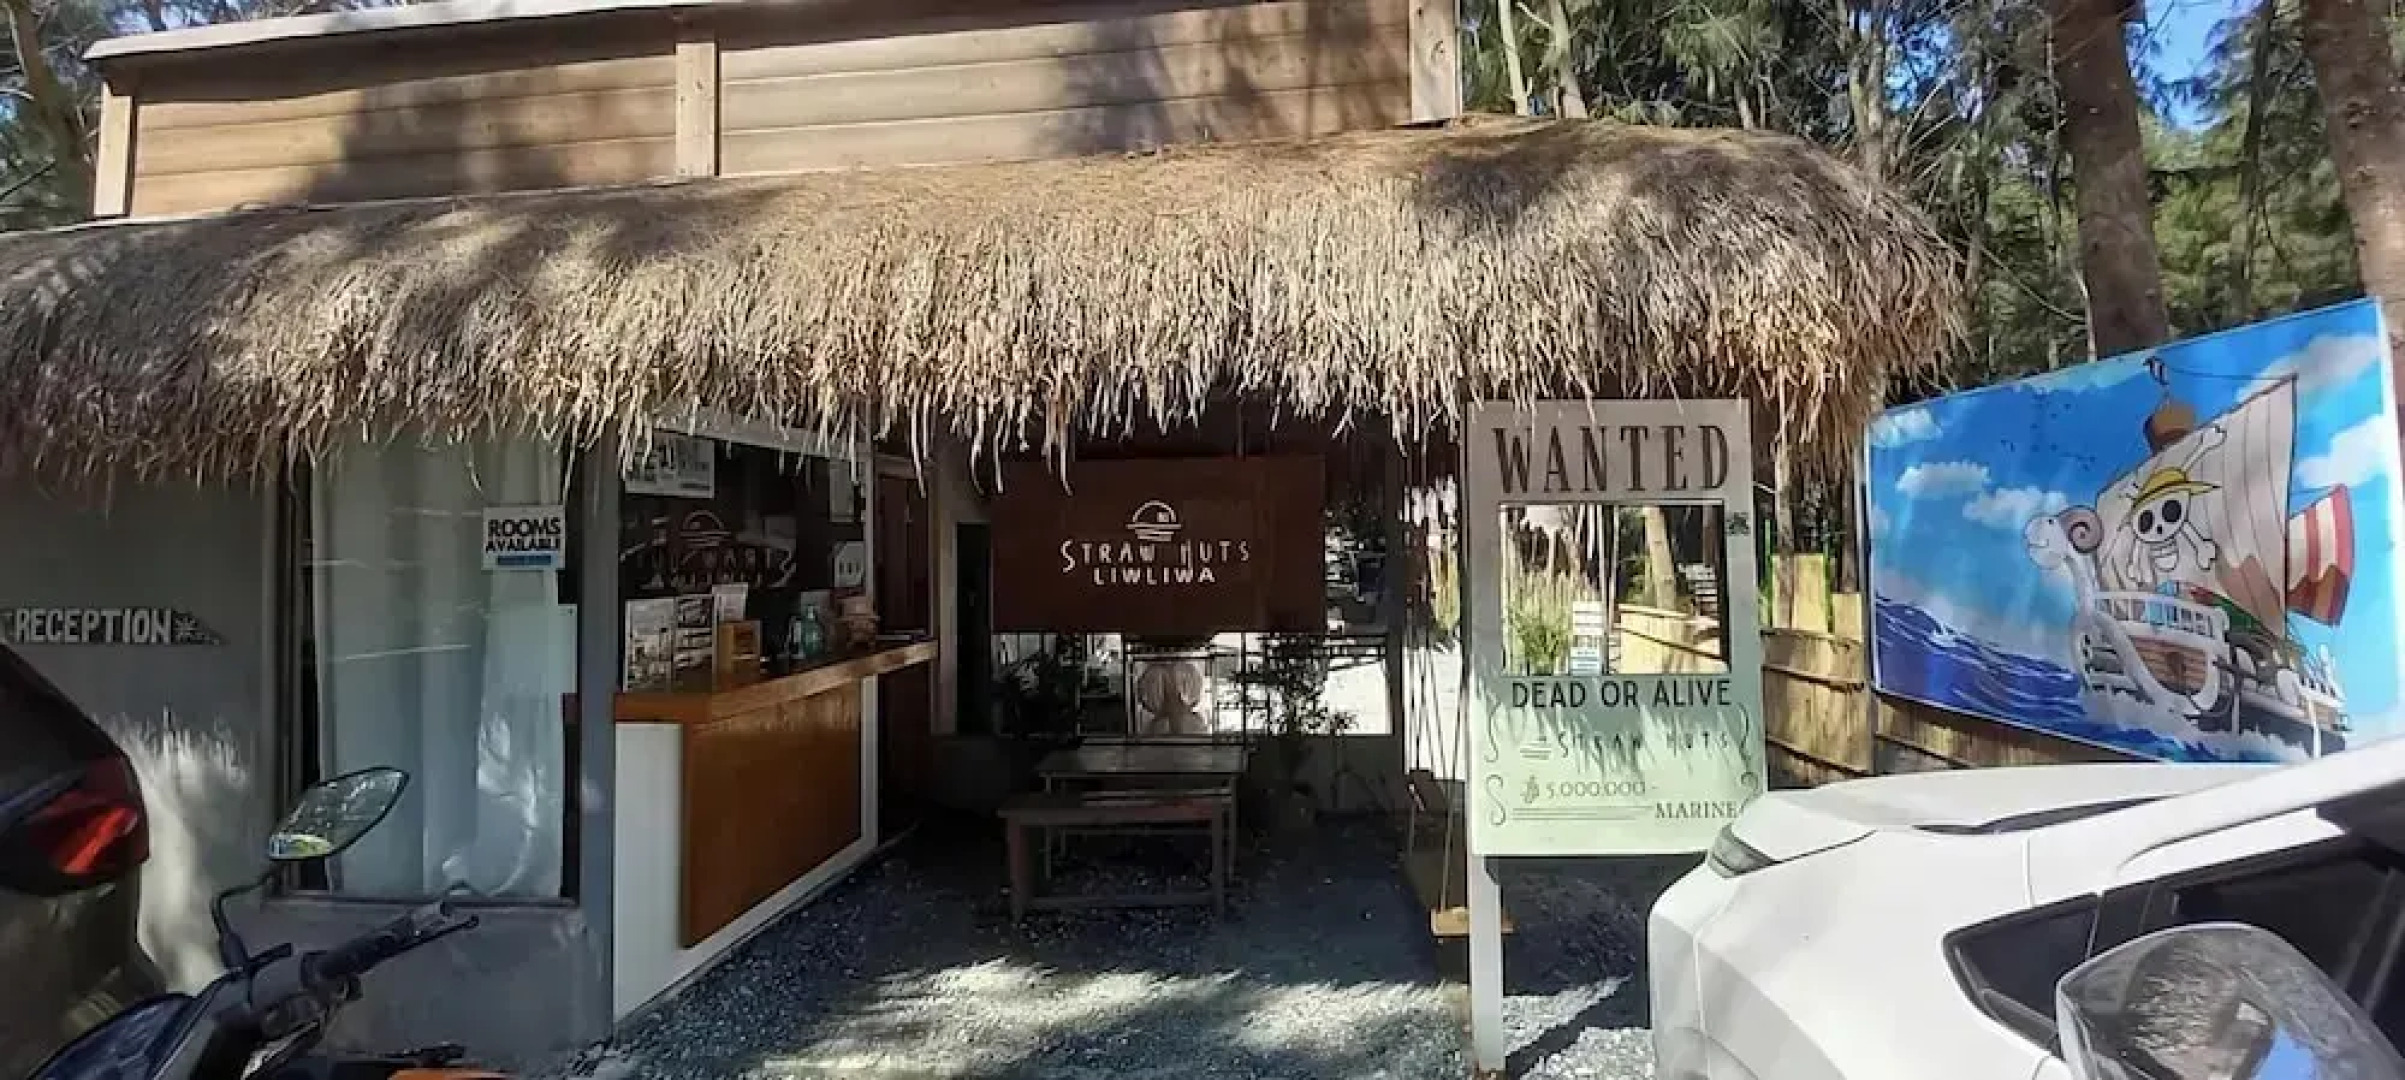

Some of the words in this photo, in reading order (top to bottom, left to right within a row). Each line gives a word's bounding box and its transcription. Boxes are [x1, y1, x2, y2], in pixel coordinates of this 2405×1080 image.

[1491, 425, 1729, 493] WANTED
[487, 516, 561, 537] ROOMS
[1060, 539, 1156, 574] STRAW
[1093, 567, 1216, 586] LIWLIWA
[16, 607, 172, 644] RECEPTION
[1512, 681, 1587, 708] DEAD
[1601, 680, 1640, 708] OR
[1652, 679, 1732, 707] ALIVE
[1655, 800, 1738, 819] MARINE
